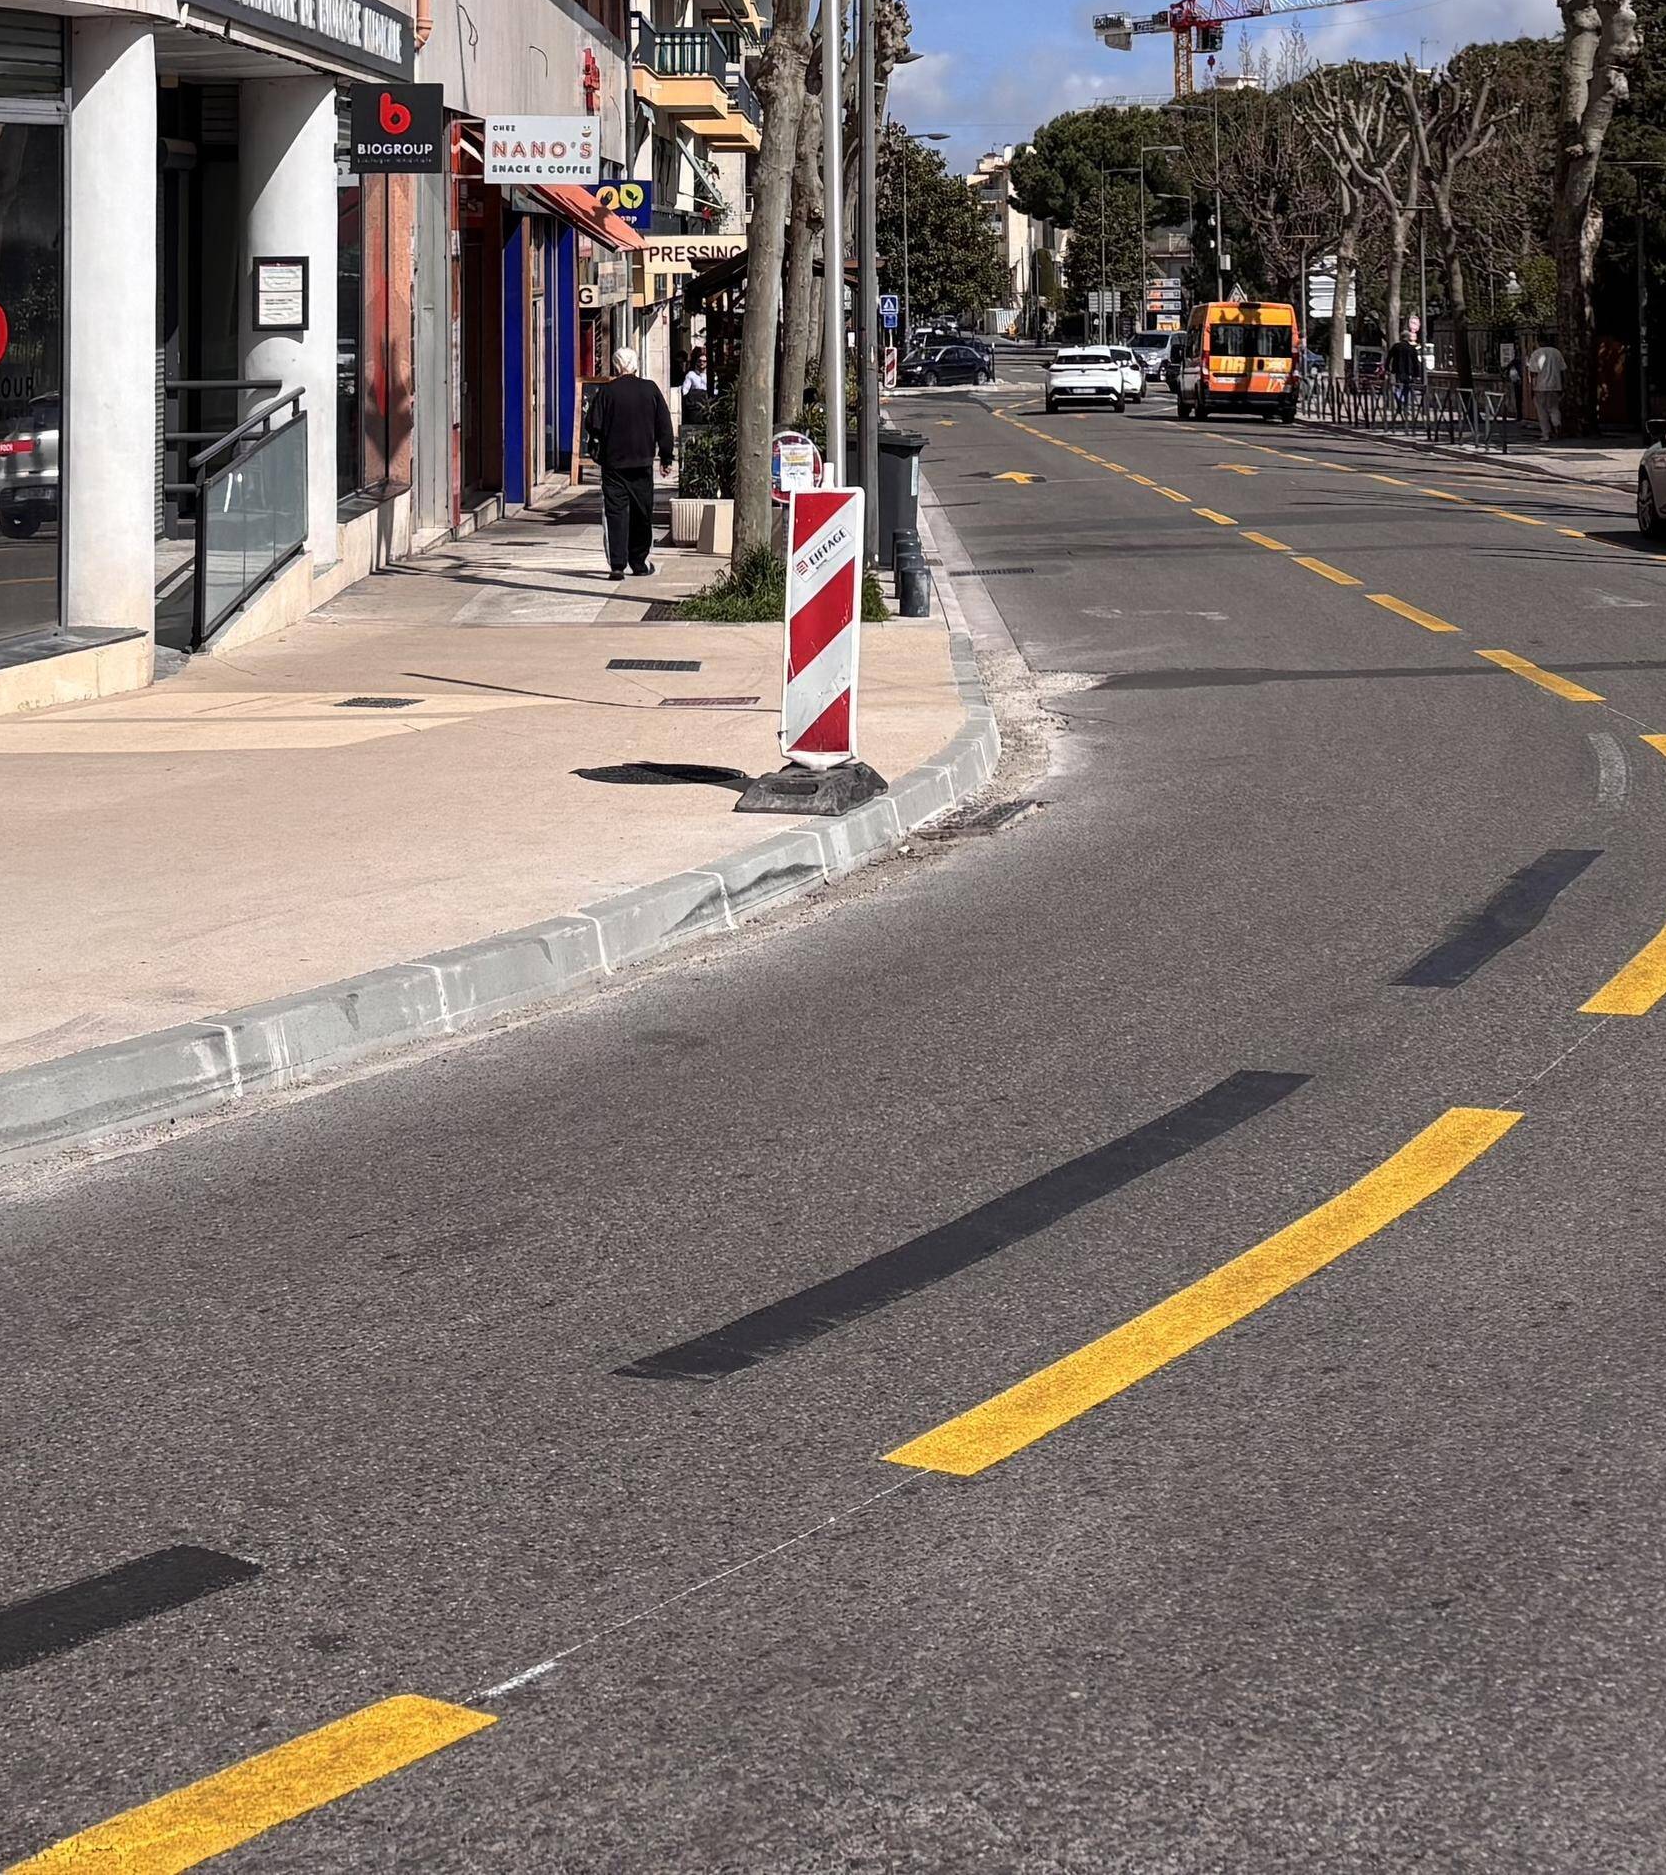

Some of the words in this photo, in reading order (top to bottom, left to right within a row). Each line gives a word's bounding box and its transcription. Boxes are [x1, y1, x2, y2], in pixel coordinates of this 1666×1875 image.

[357, 143, 433, 155] BIOGROUP
[492, 140, 592, 159] NANO'S
[492, 165, 531, 173] SNACK
[548, 165, 592, 174] COFFEE
[809, 528, 847, 565] EIFFAGE
